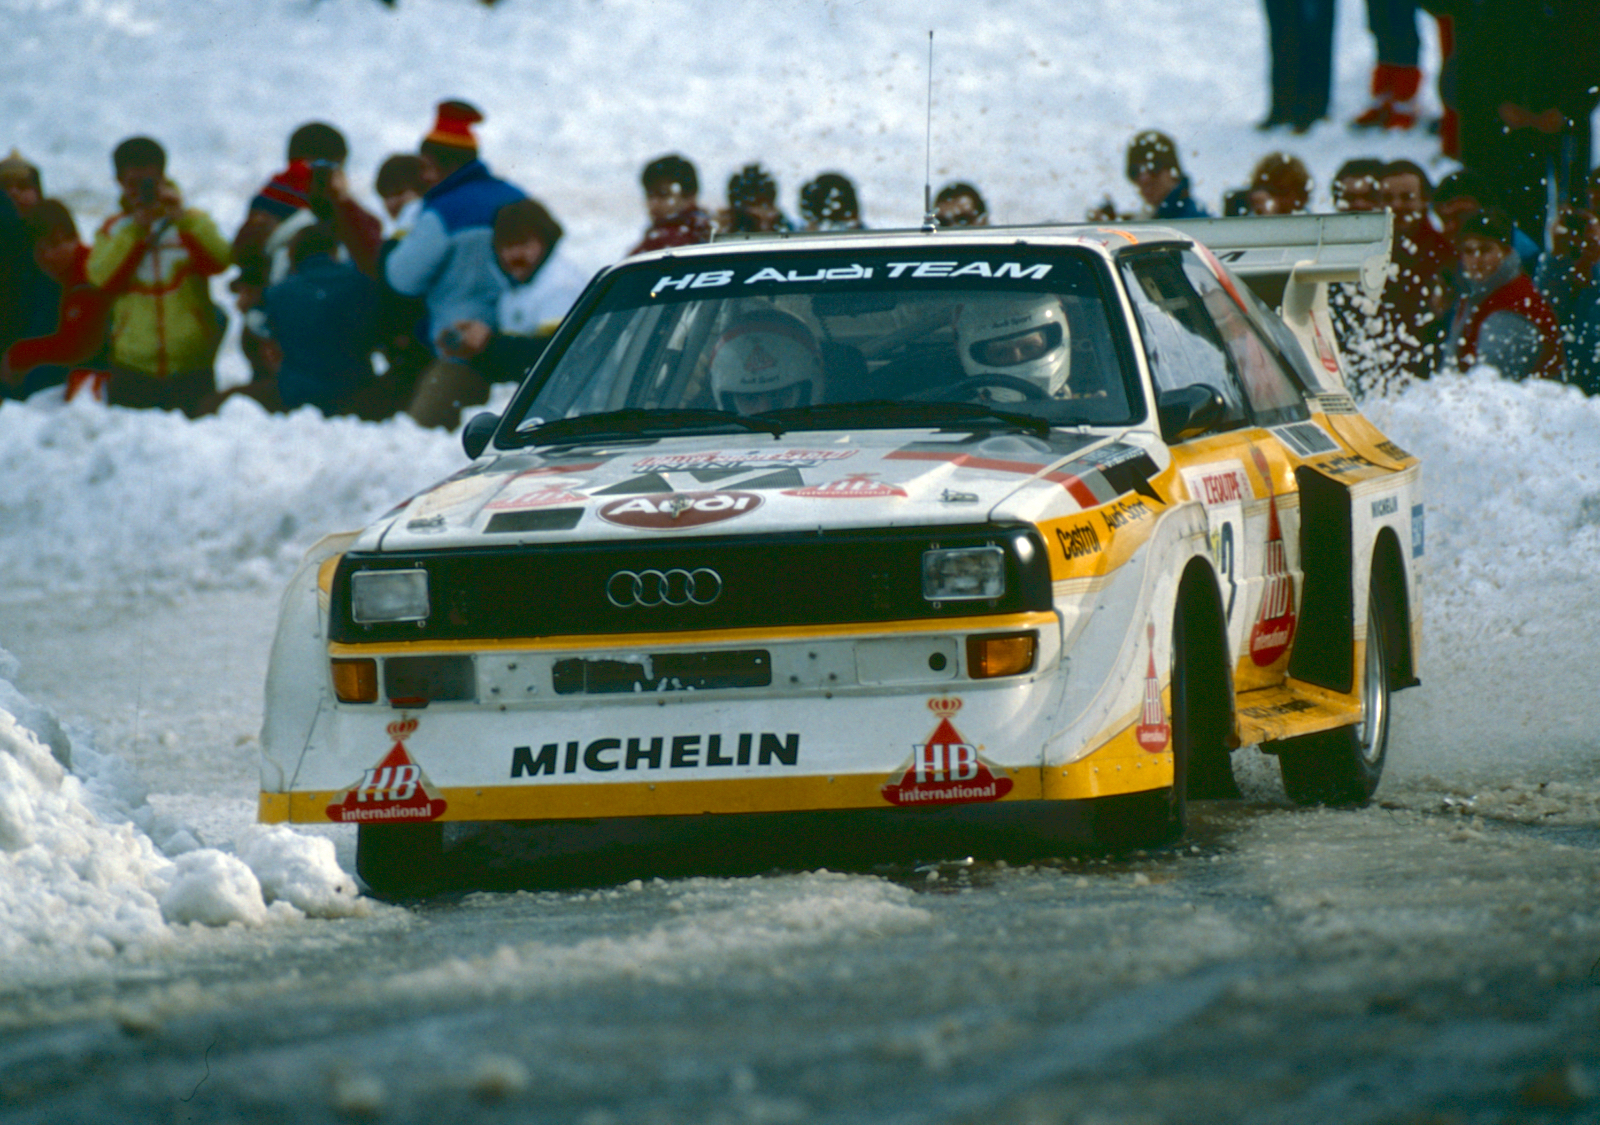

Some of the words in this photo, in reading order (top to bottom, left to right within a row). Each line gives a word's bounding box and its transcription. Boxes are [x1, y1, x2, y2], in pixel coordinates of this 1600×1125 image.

[651, 270, 735, 293] HB
[743, 253, 874, 284] Audi
[886, 261, 1053, 280] TEAM
[1100, 504, 1130, 533] Audi
[1117, 498, 1153, 521] Sport
[1055, 520, 1102, 561] Castrol
[1145, 678, 1161, 725] HB
[510, 733, 800, 778] MICHELIN
[912, 743, 978, 783] HB
[356, 764, 421, 802] HB
[898, 782, 996, 802] international
[341, 802, 432, 821] international
